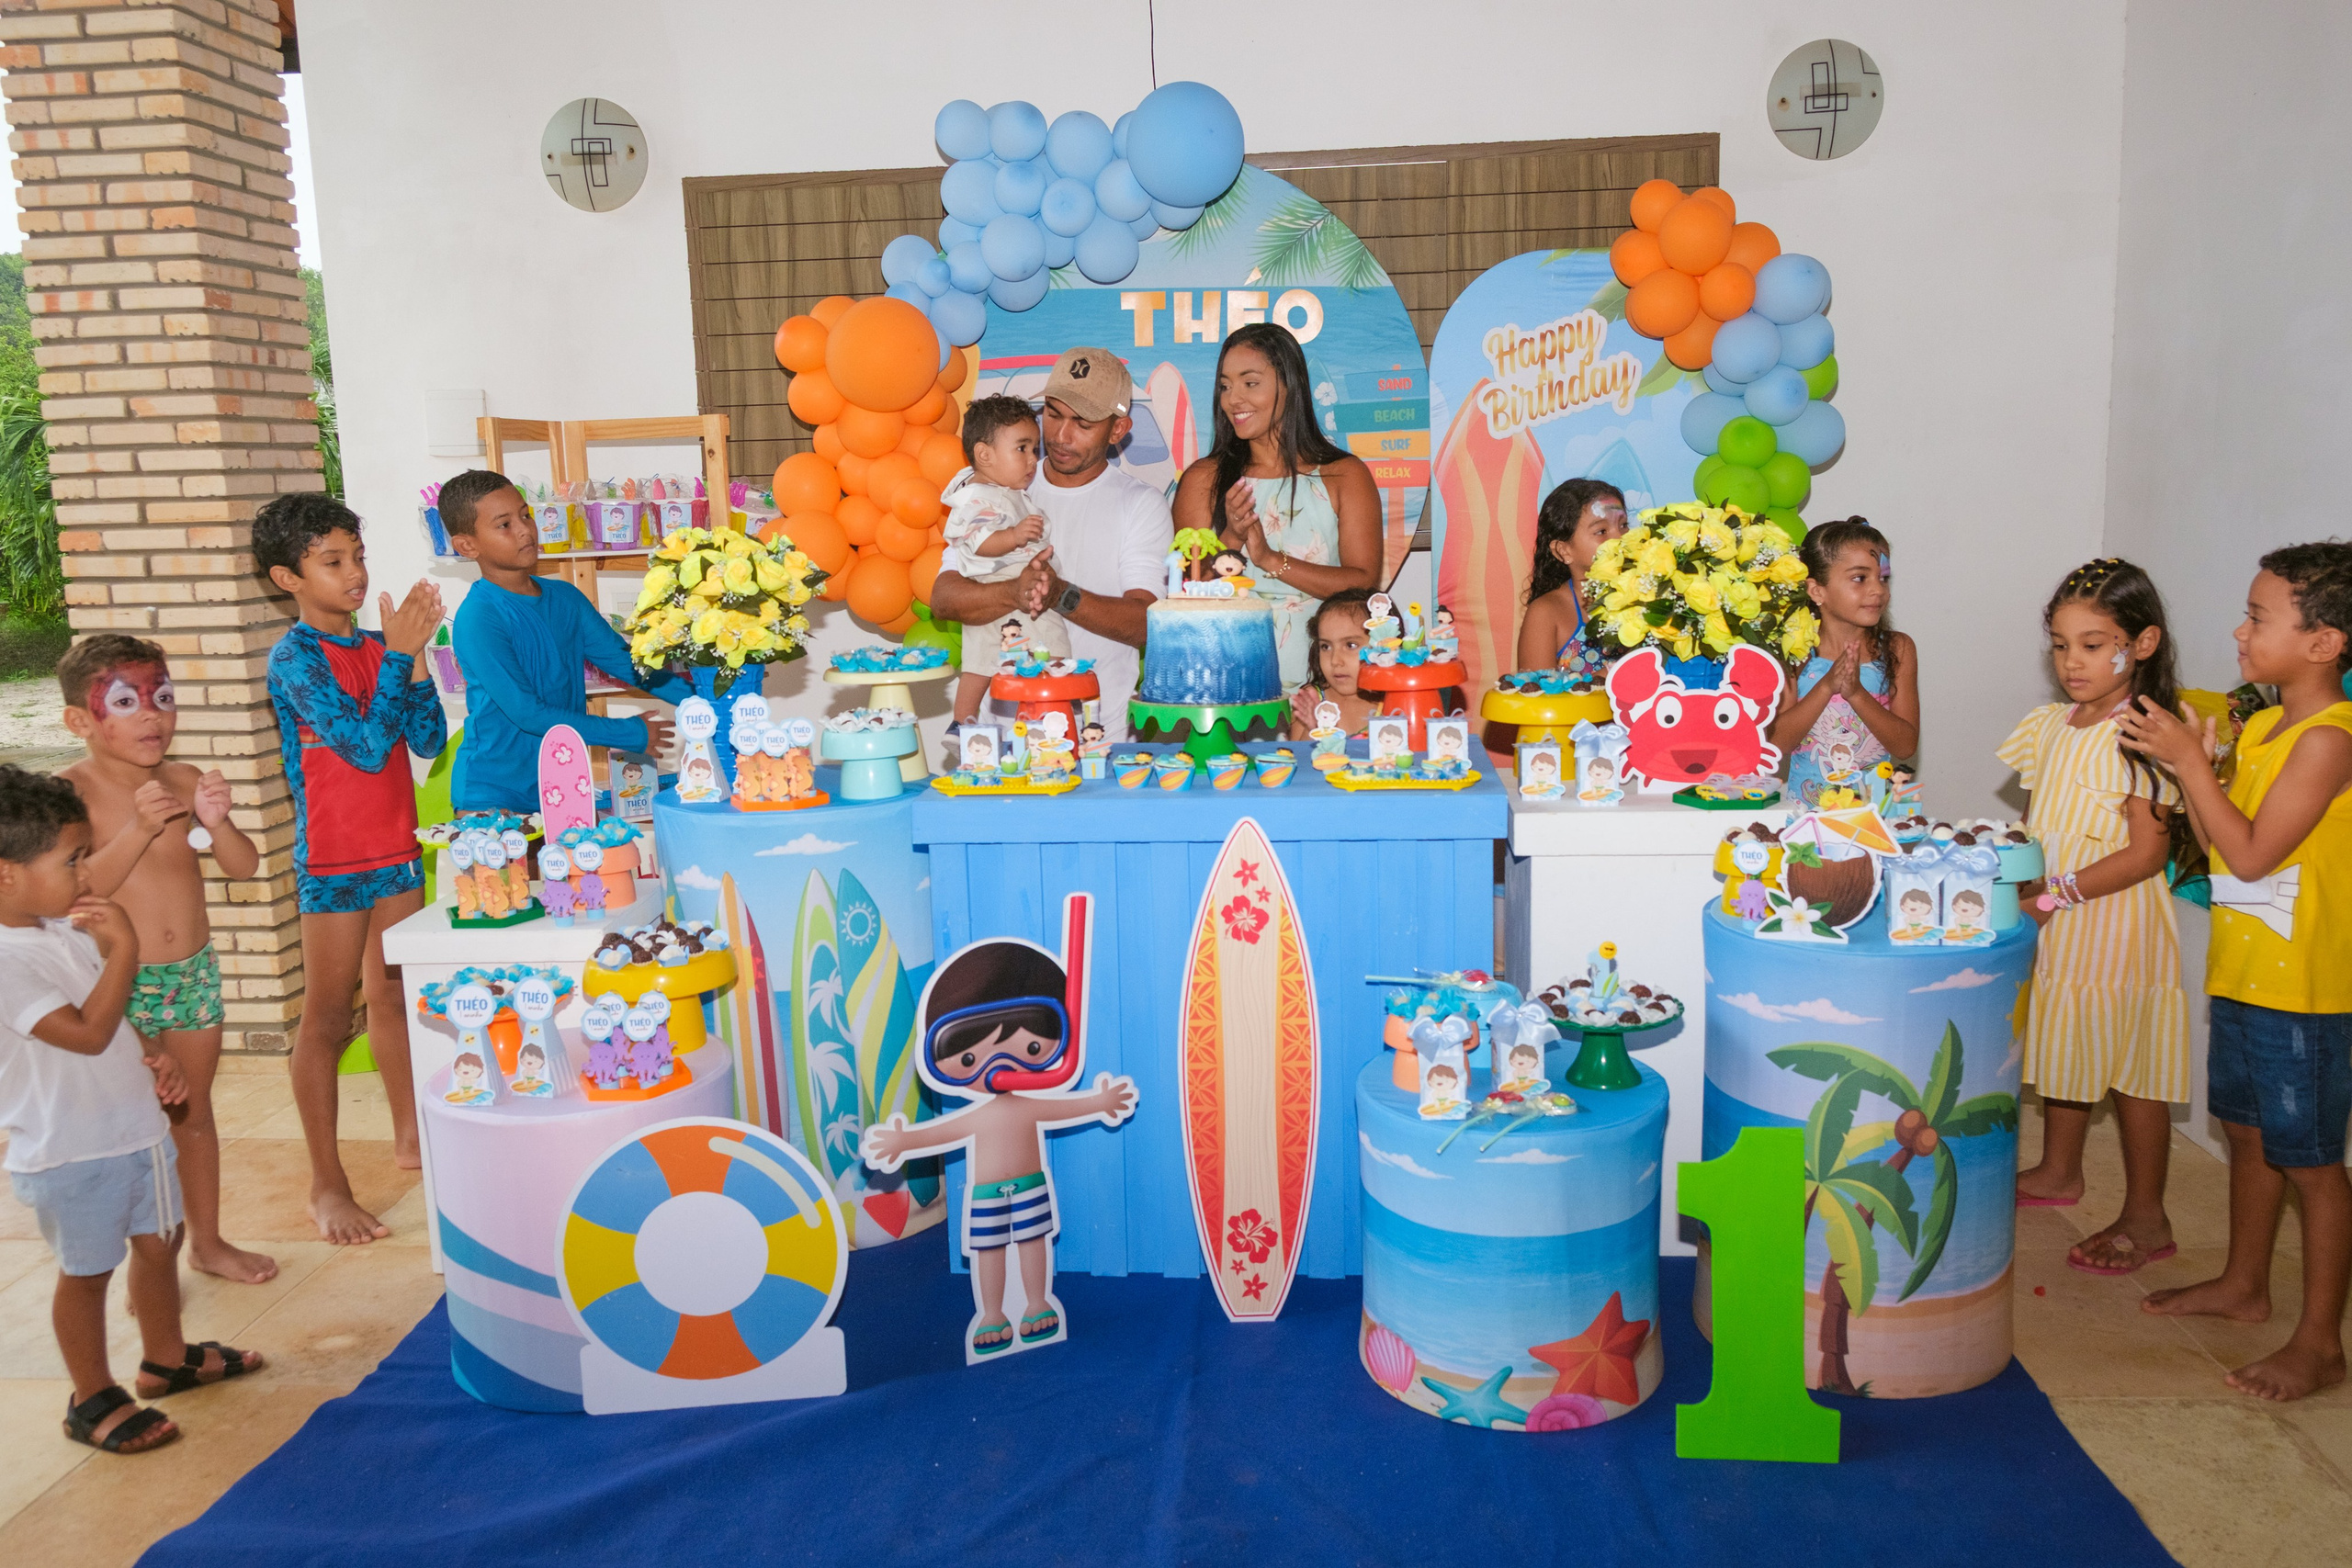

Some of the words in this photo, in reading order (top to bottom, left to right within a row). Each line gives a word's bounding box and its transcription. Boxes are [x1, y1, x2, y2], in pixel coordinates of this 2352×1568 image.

[1120, 265, 1324, 347] THÉO
[1487, 315, 1600, 380] Happy
[1377, 378, 1412, 391] SAND
[1482, 357, 1635, 432] Birthday
[1374, 408, 1415, 423] BEACH
[1381, 438, 1411, 451] SURF
[1375, 467, 1411, 479] RELAX
[1184, 579, 1235, 597] THÉO
[739, 705, 764, 716] THÉO
[685, 713, 711, 725] THÉO
[740, 735, 758, 743] THÉO
[765, 735, 786, 744] THÉO
[627, 798, 647, 807] THÉO
[579, 850, 598, 859] THÉO
[1740, 851, 1762, 860] THÉO
[547, 858, 565, 867] THÉO
[521, 989, 548, 1004] THÉO
[455, 996, 488, 1011] THÉO
[587, 1017, 608, 1026] THÉO
[629, 1017, 651, 1027] THÉO
[1676, 1126, 1841, 1464] 1
